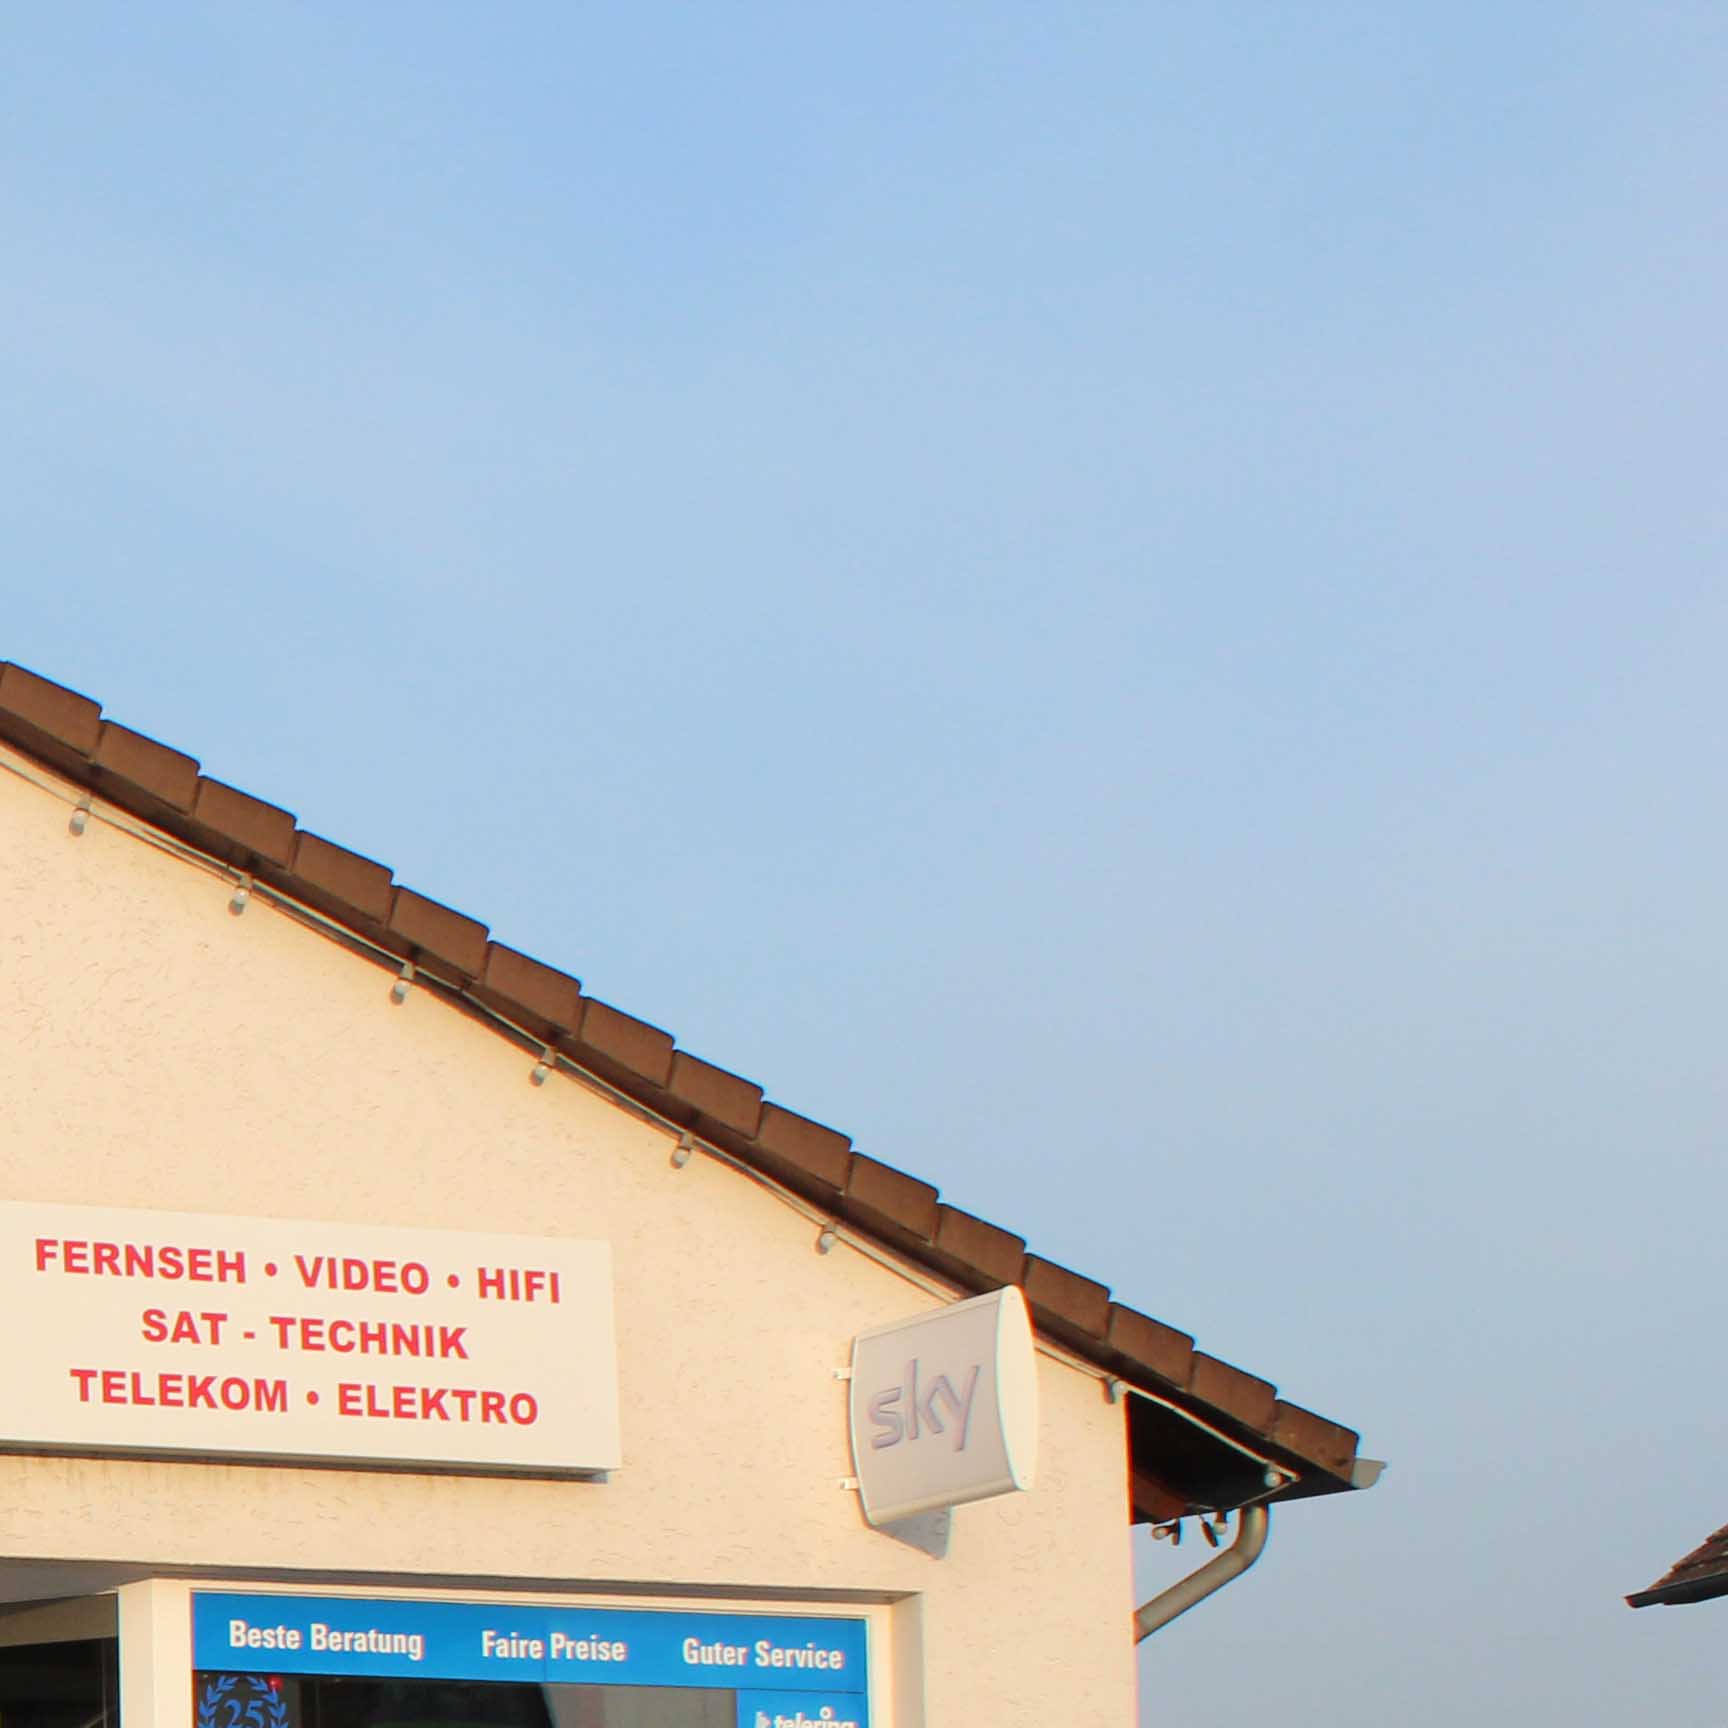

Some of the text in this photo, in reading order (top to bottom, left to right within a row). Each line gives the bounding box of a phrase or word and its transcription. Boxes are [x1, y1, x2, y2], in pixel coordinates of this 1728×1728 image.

[34, 1238, 562, 1305] FERNSEH VIDEO HIFI
[141, 1308, 228, 1347] SAT
[270, 1316, 469, 1360] TECHNIK
[69, 1369, 539, 1426] TELEKOM ELEKTRO
[867, 1358, 979, 1452] sky
[229, 1620, 424, 1660] Beste Beratung
[482, 1630, 627, 1662] Faire Preise
[683, 1637, 845, 1669] Guter Service
